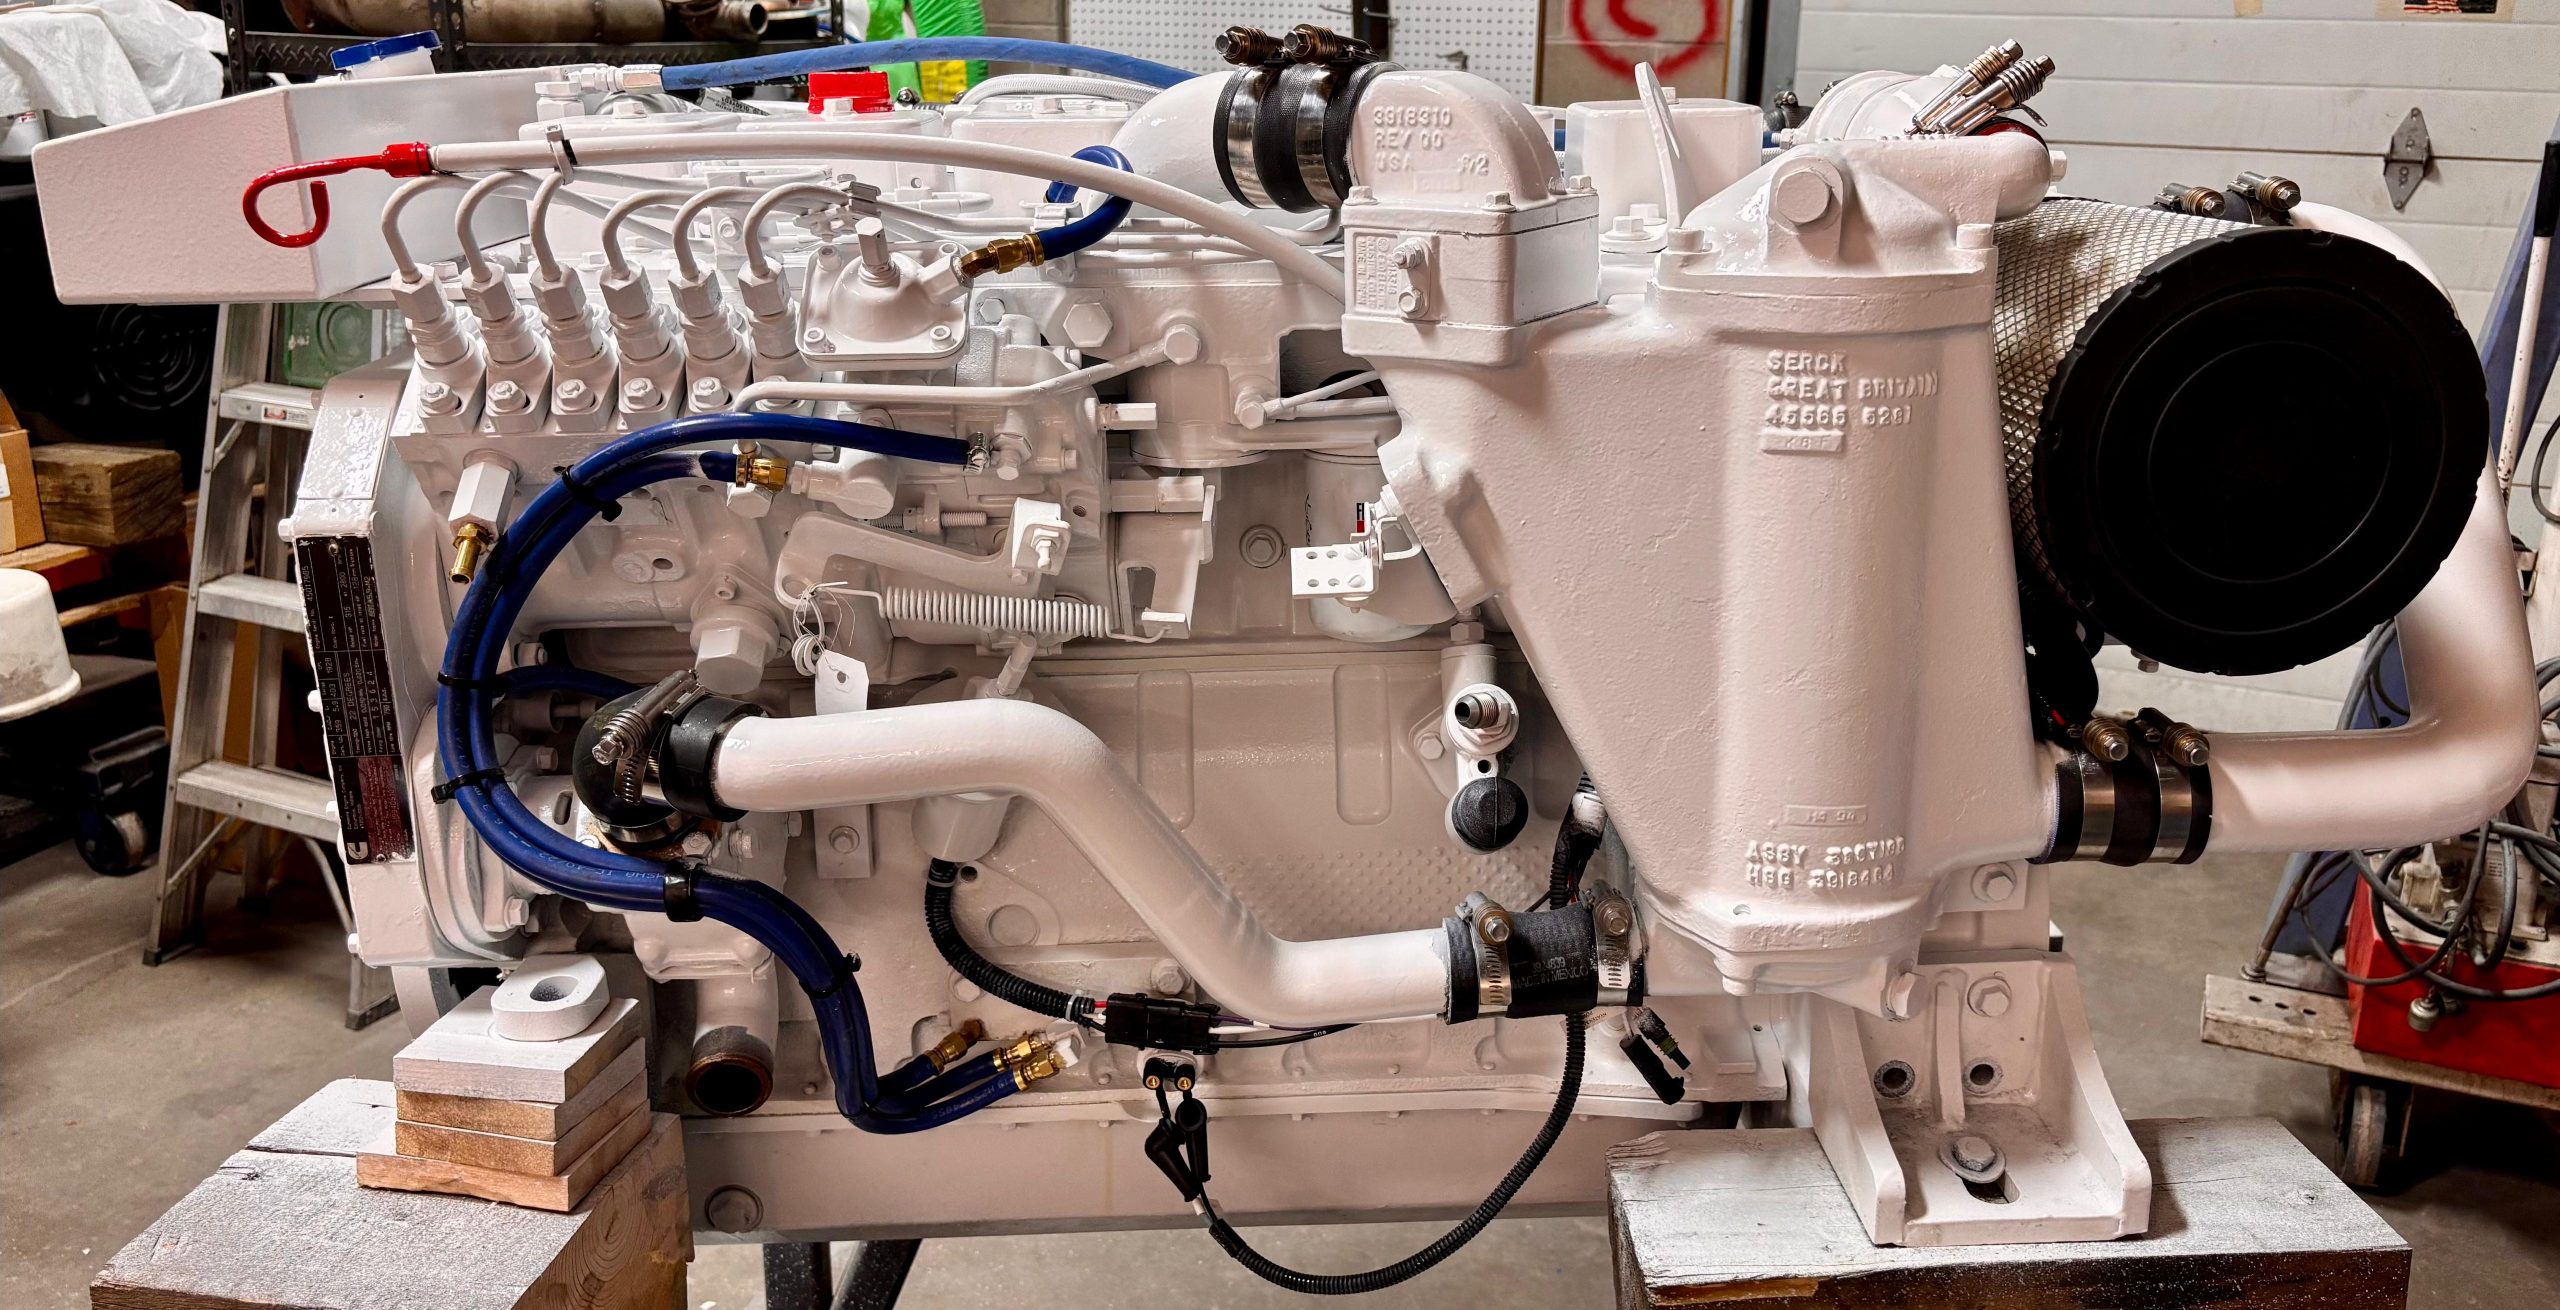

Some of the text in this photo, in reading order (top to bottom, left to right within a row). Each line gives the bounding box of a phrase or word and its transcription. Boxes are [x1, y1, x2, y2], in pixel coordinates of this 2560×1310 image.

[1373, 106, 1452, 127] 3918310
[1766, 349, 1848, 375] SERCK
[1766, 371, 1939, 400] GREAT BRITAIN
[1744, 840, 1808, 867] ASSY
[1551, 965, 1589, 982] MEXICO
